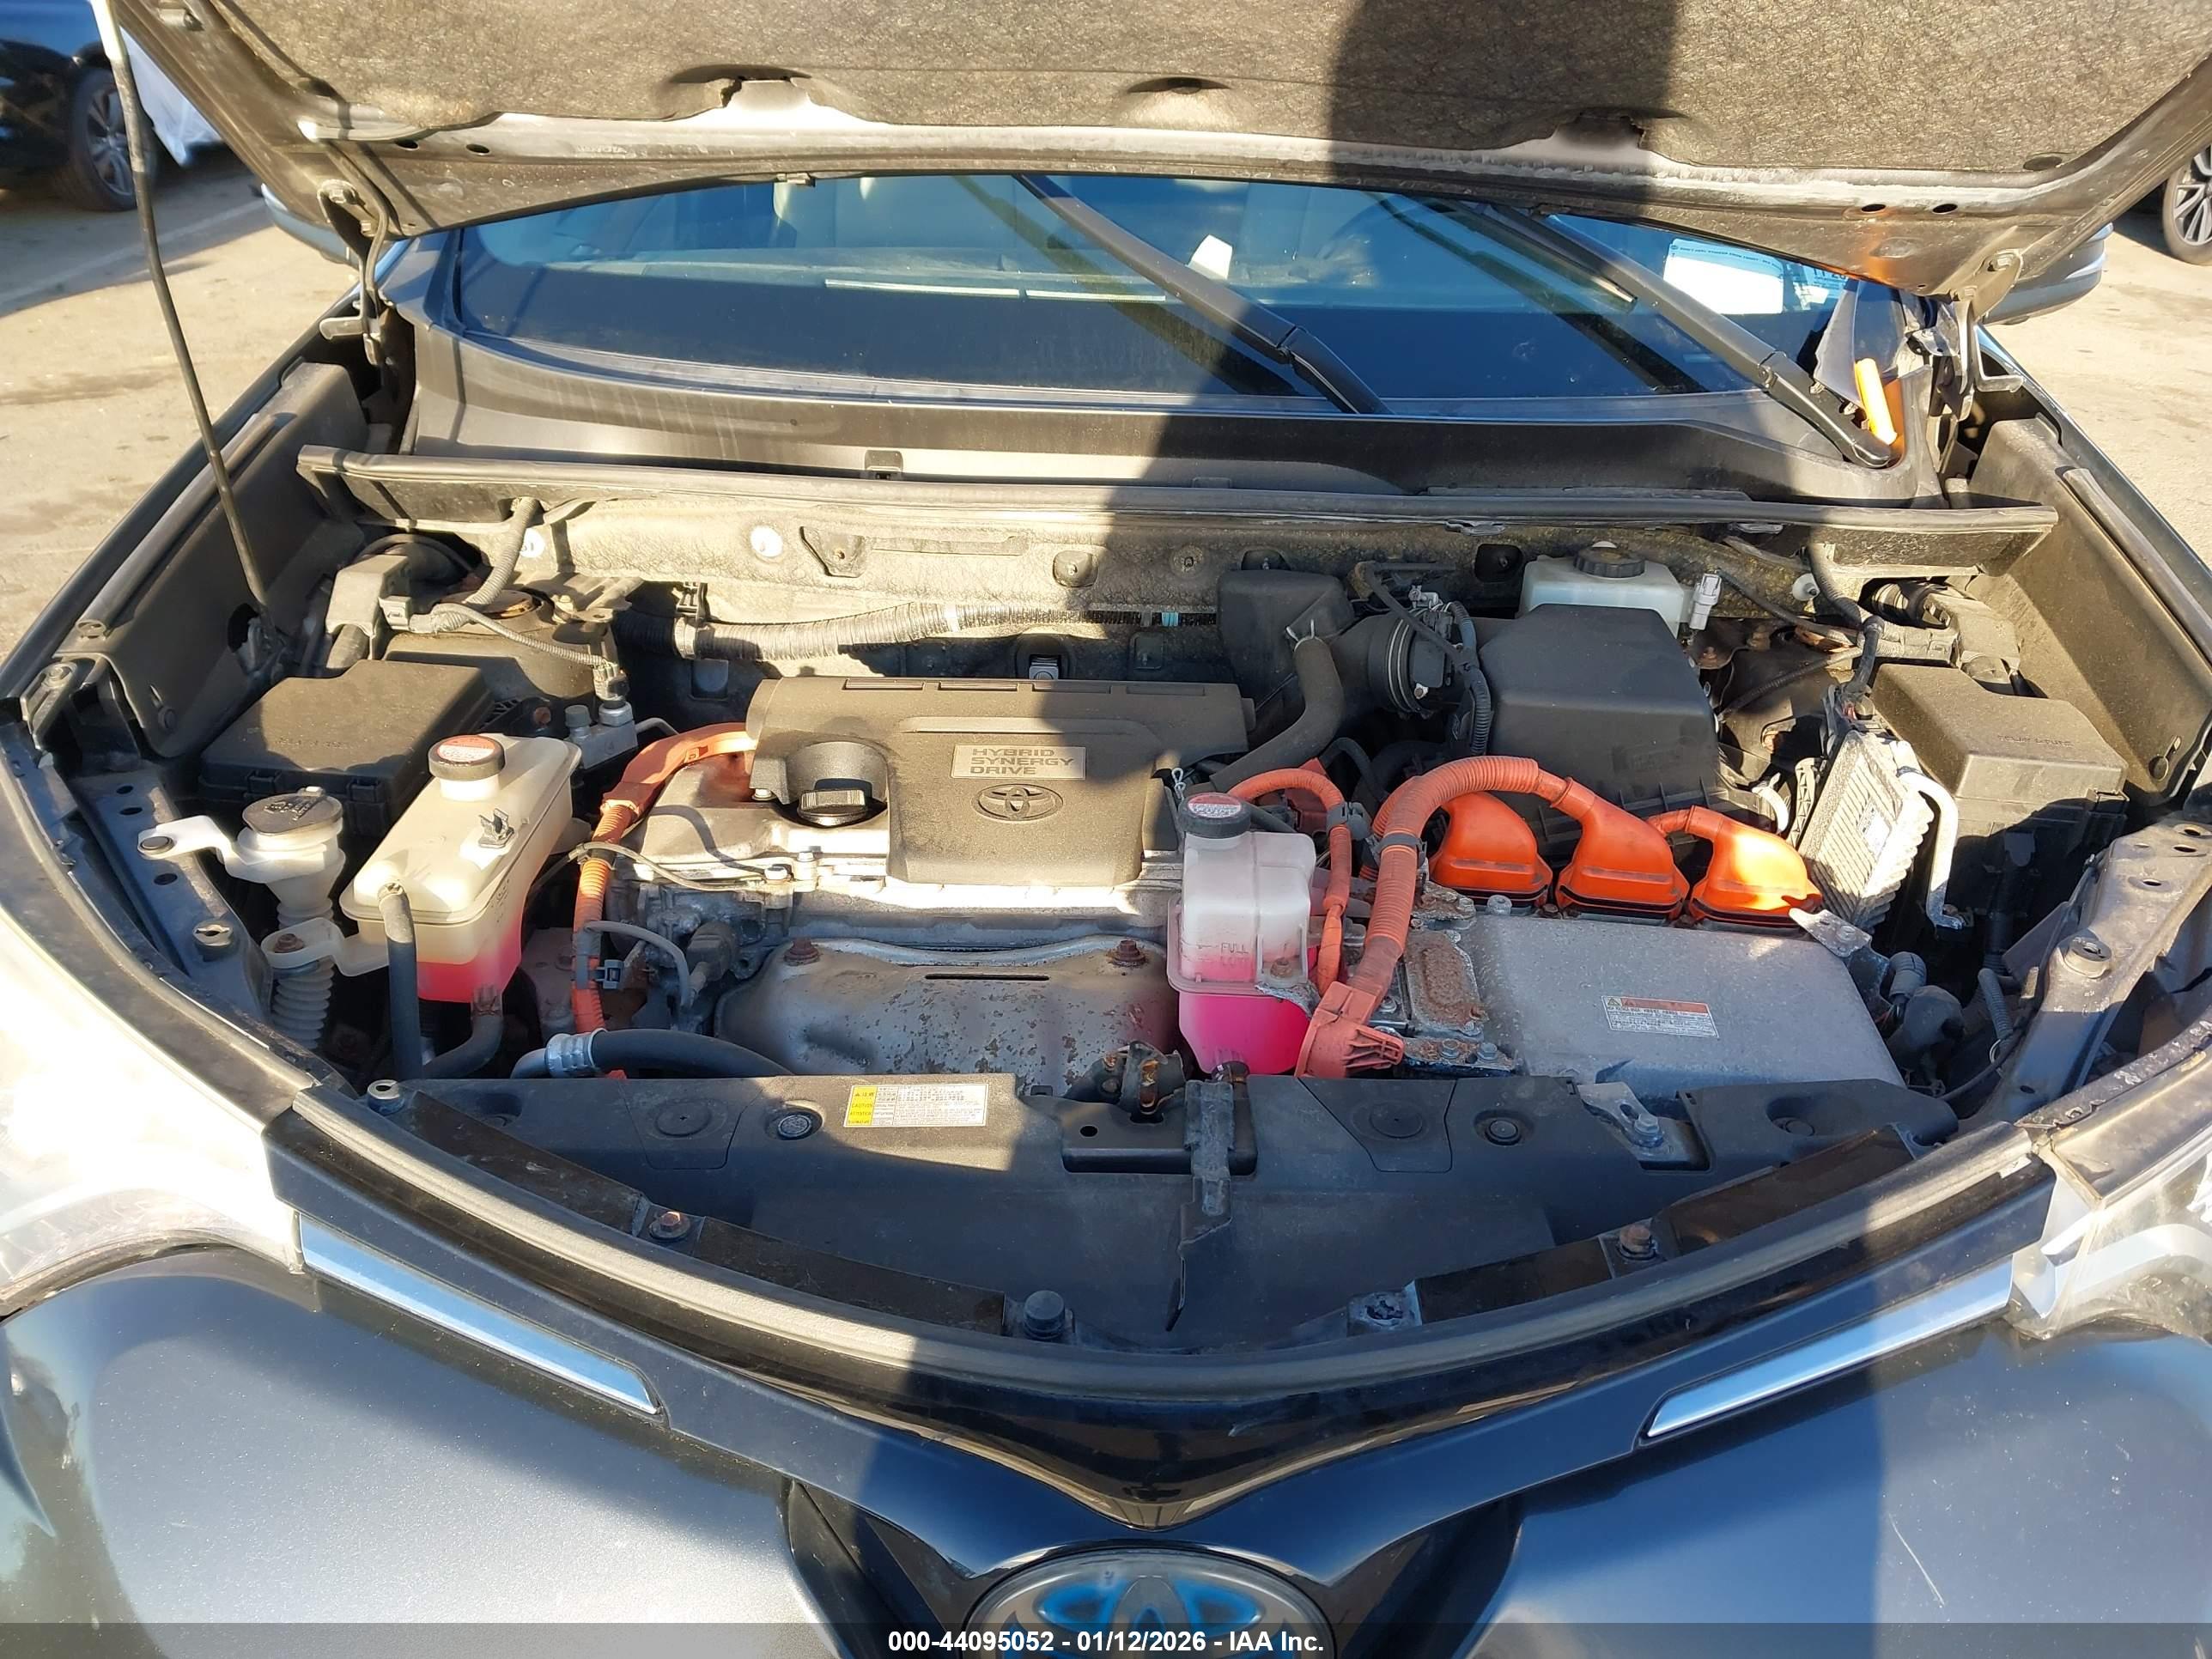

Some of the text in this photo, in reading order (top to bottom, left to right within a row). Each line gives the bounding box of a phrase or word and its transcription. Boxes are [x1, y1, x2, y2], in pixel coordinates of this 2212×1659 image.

[972, 748, 1054, 757] HYBRID
[970, 757, 1074, 766] SYNERGY
[969, 766, 1037, 775] DRIVE
[1220, 942, 1249, 954] FULL
